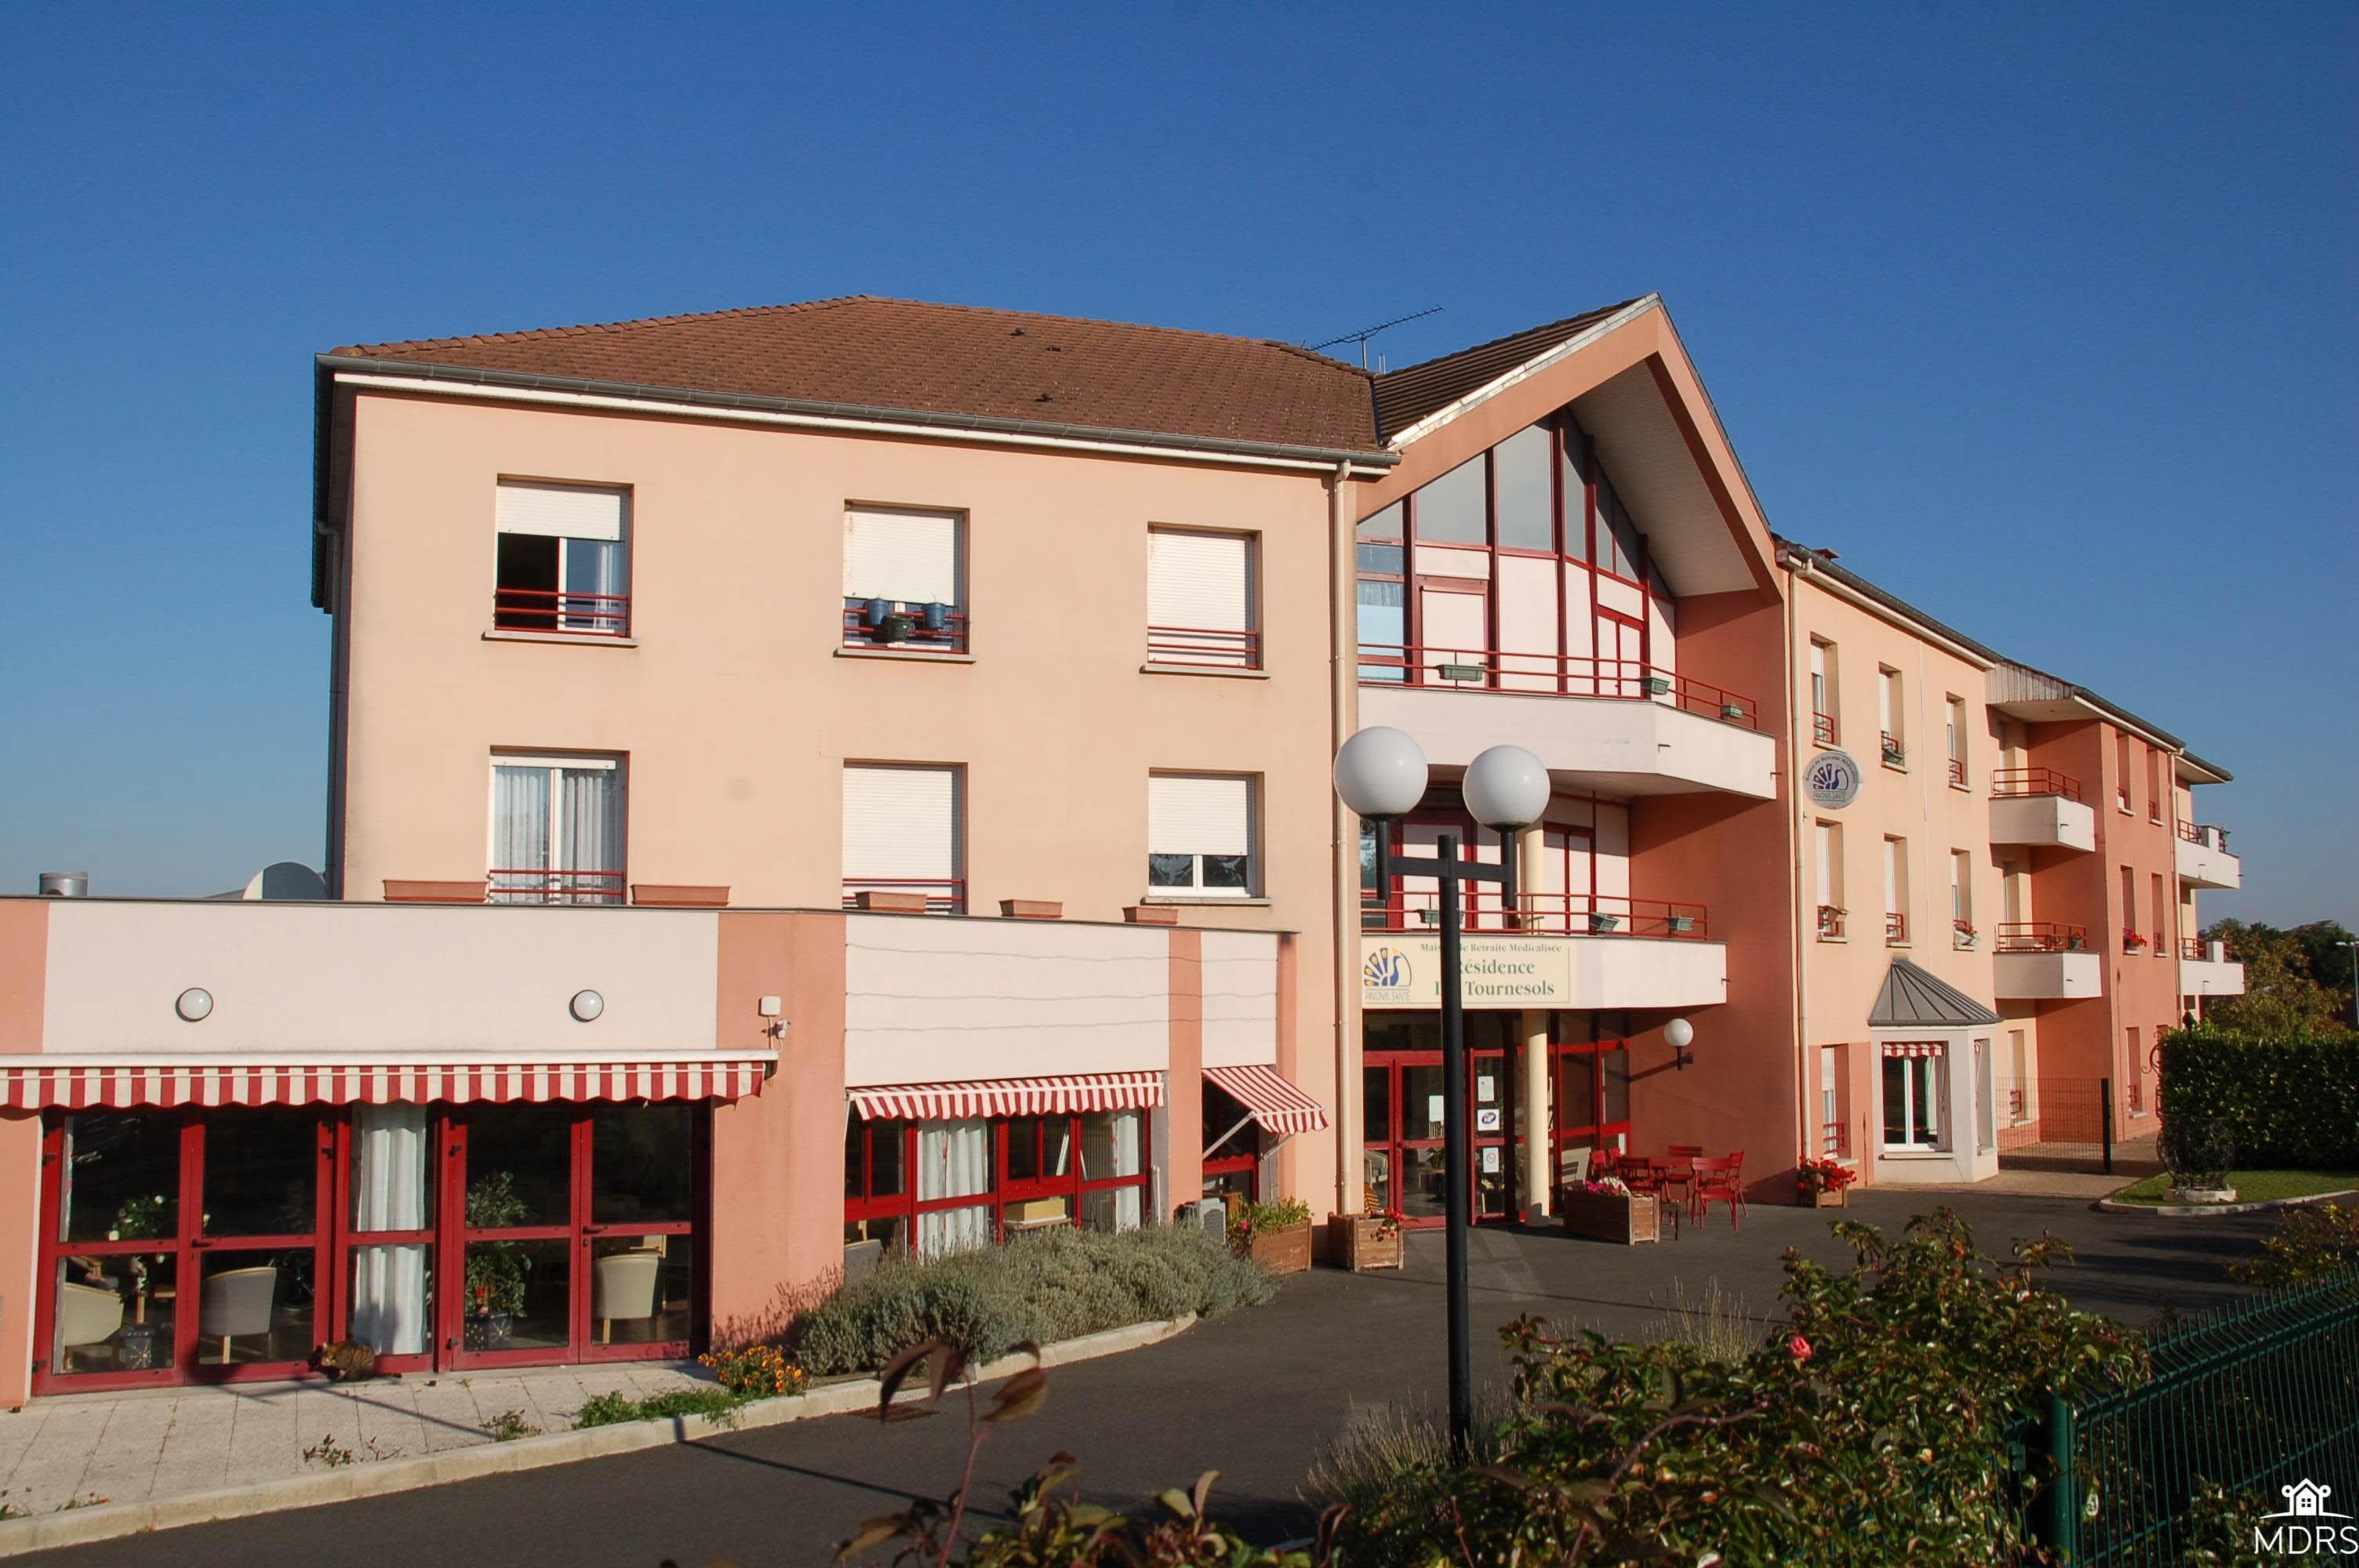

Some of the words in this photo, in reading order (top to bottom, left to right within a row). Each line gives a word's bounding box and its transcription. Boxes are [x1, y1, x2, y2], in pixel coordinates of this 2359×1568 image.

[1470, 943, 1507, 952] Retraite
[1460, 959, 1535, 974] ésidence
[1465, 980, 1554, 996] Tournesols
